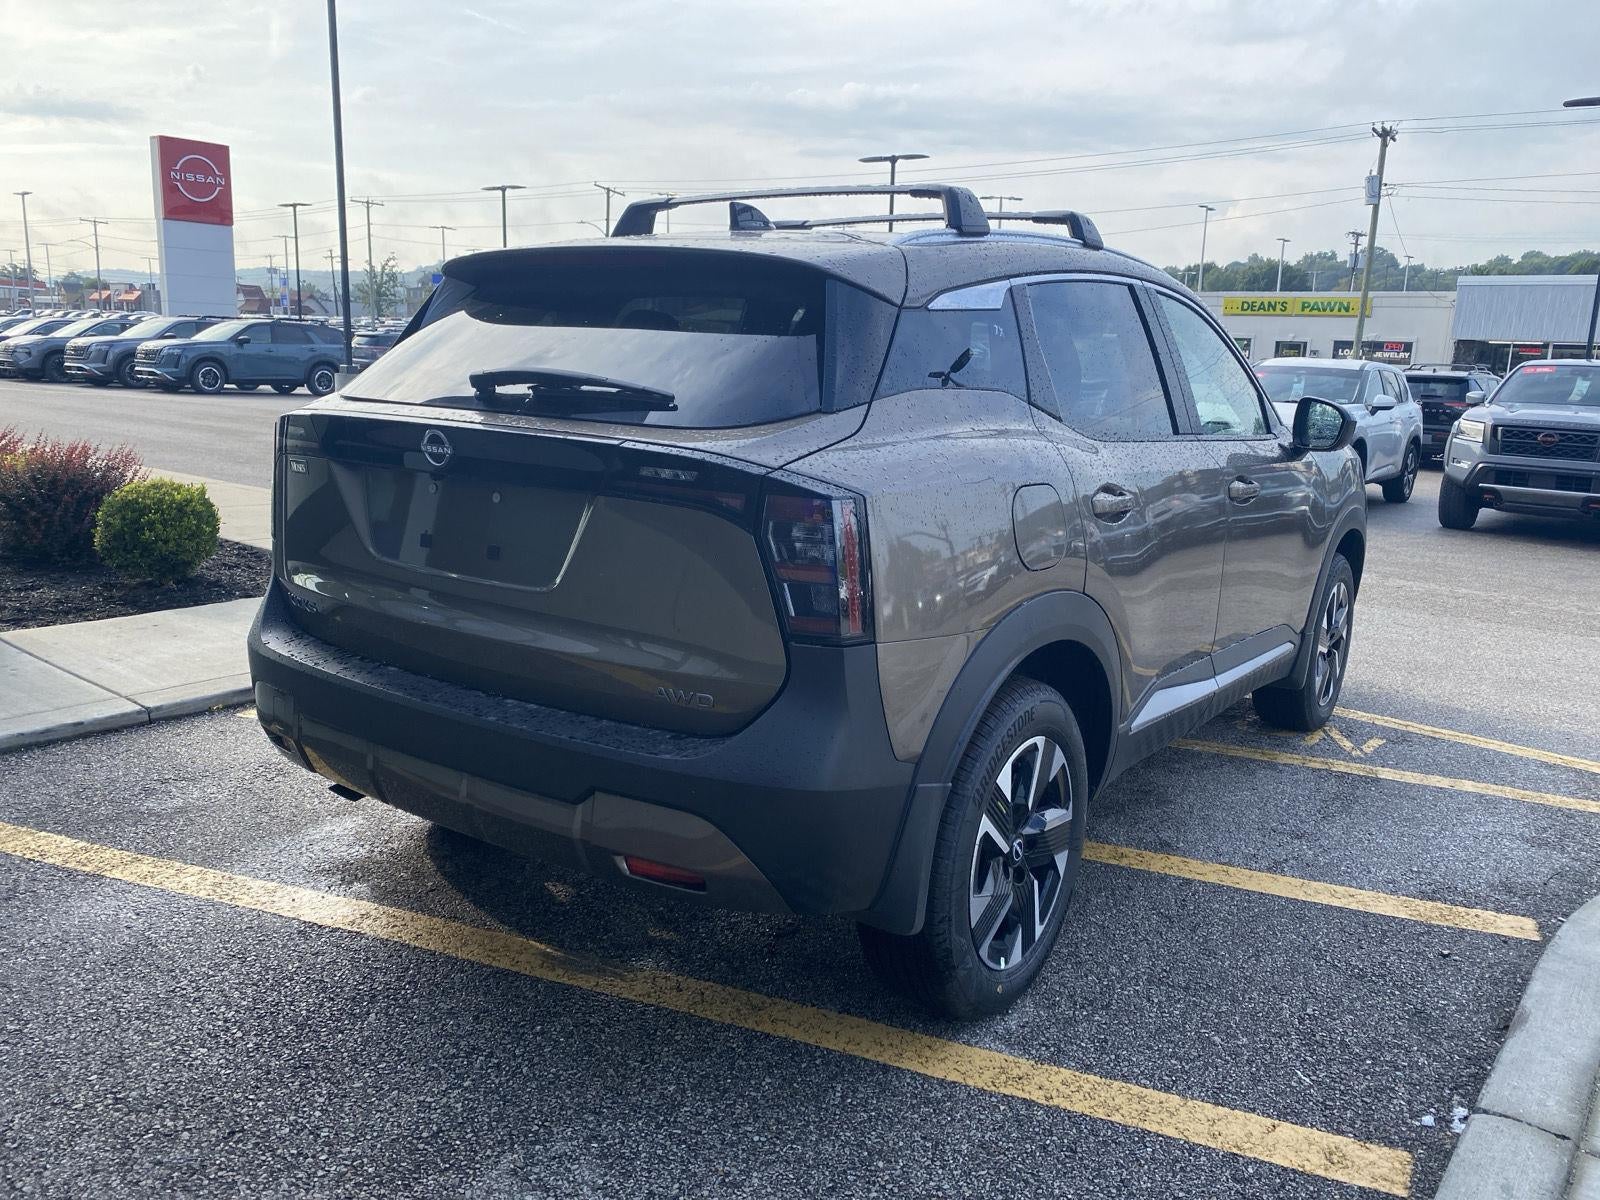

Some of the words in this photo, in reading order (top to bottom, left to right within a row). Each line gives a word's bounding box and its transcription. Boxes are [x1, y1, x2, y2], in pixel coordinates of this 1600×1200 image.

[170, 171, 225, 185] NISSAN
[1373, 351, 1410, 359] JEWELRY
[420, 442, 451, 454] NISSAN
[656, 686, 714, 708] AWD
[973, 706, 1036, 810] BRIDGESTONE
